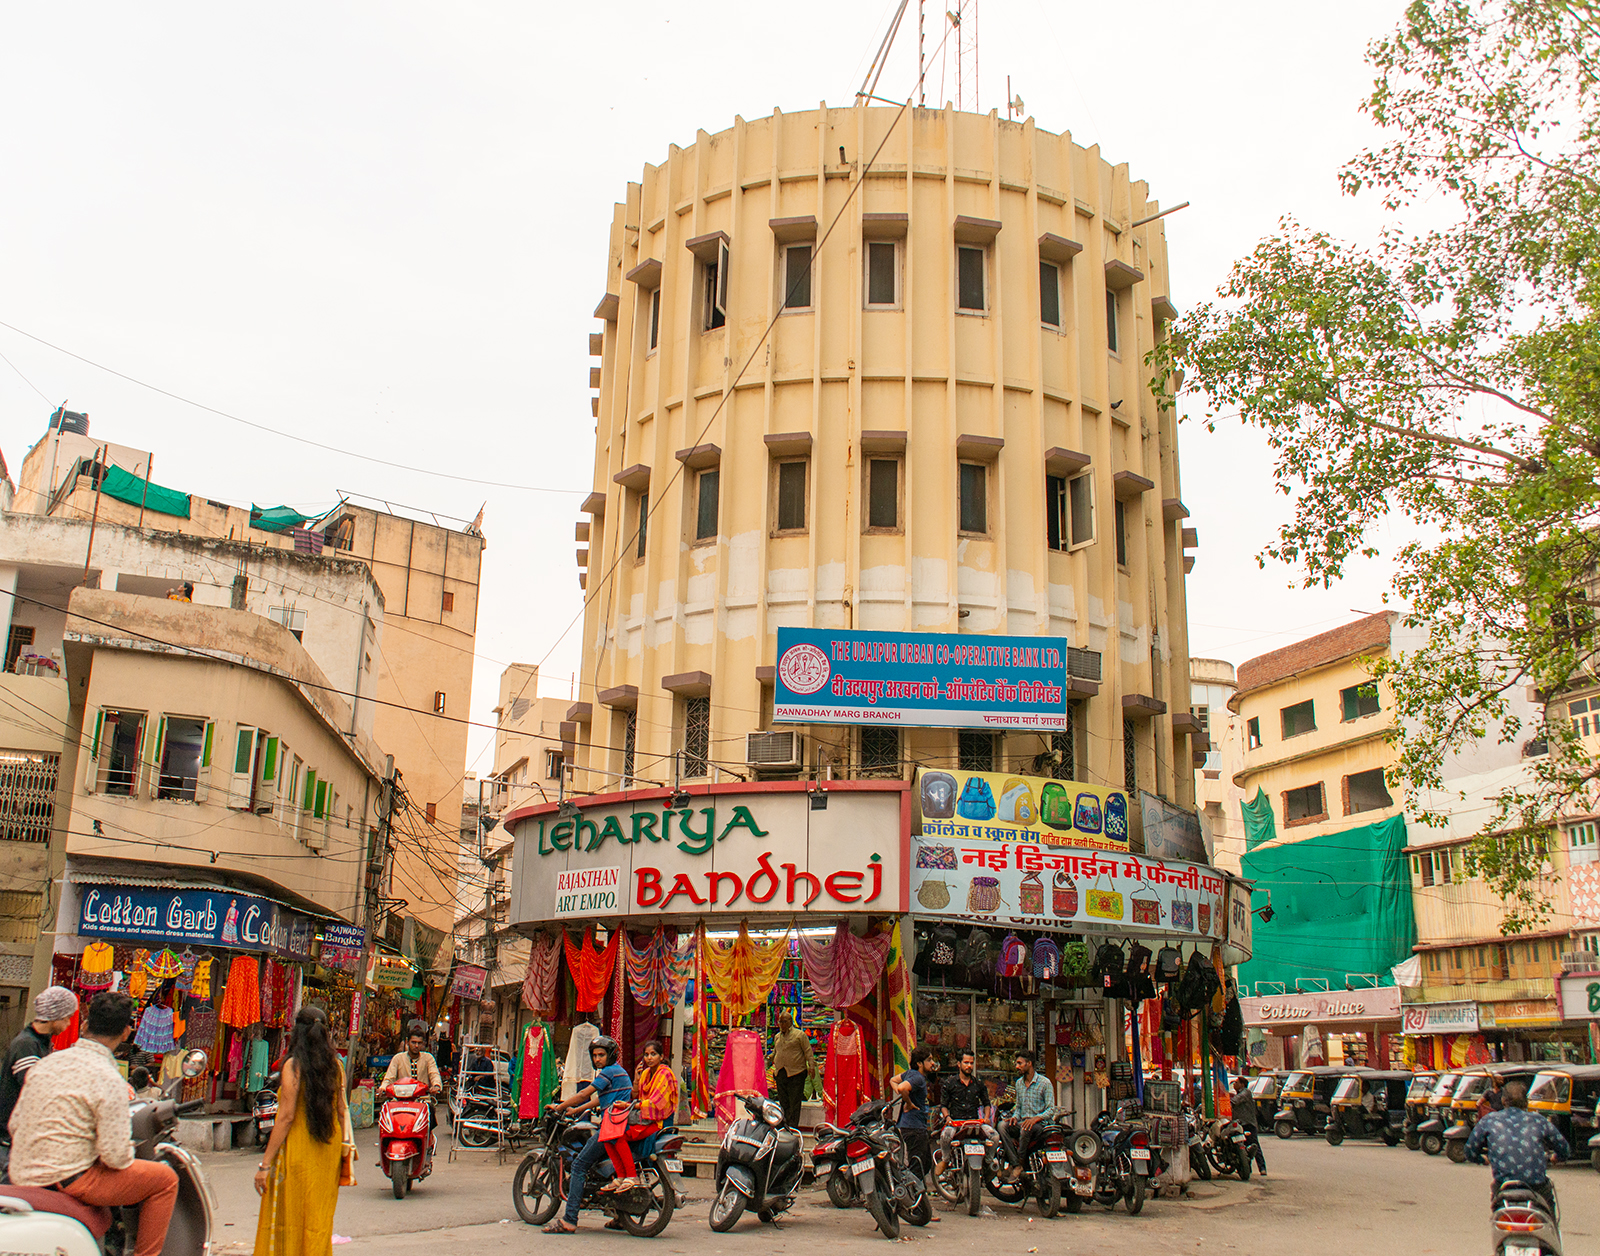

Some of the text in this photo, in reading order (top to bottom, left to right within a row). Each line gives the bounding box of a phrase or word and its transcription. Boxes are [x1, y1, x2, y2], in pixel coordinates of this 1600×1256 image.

[831, 641, 1064, 668] THE UDAIPUR URBAN CO-OPERATIVE BANK LTD.
[831, 673, 844, 697] दी
[845, 678, 885, 704] उदयपुर
[886, 679, 921, 698] अरबन
[996, 678, 1017, 702] बैंक
[1018, 680, 1062, 703] लिमिटेड
[776, 707, 901, 720] PANNADHAY MARG BRANCH
[983, 713, 1065, 726] पन्नाधाय मार्ग शाखा
[922, 819, 970, 837] कॉलेज
[972, 825, 982, 838] व
[985, 827, 1018, 842] स्कूल
[961, 844, 1010, 872] नई
[1122, 856, 1142, 882] मे
[1146, 860, 1200, 891] फैन्सी
[558, 868, 619, 892] RAJASTHAN
[84, 889, 217, 931] Cotton Garb
[555, 891, 617, 913] ART EMPO.
[82, 923, 98, 931] Kids
[99, 924, 126, 933] dresses
[126, 926, 140, 934] and
[141, 928, 164, 936] women
[185, 931, 215, 939] materials
[325, 932, 362, 946] Bangles
[352, 992, 361, 1031] BANGLES
[1259, 1003, 1311, 1019] Cotton
[1428, 1008, 1475, 1025] HANDICRAFTS
